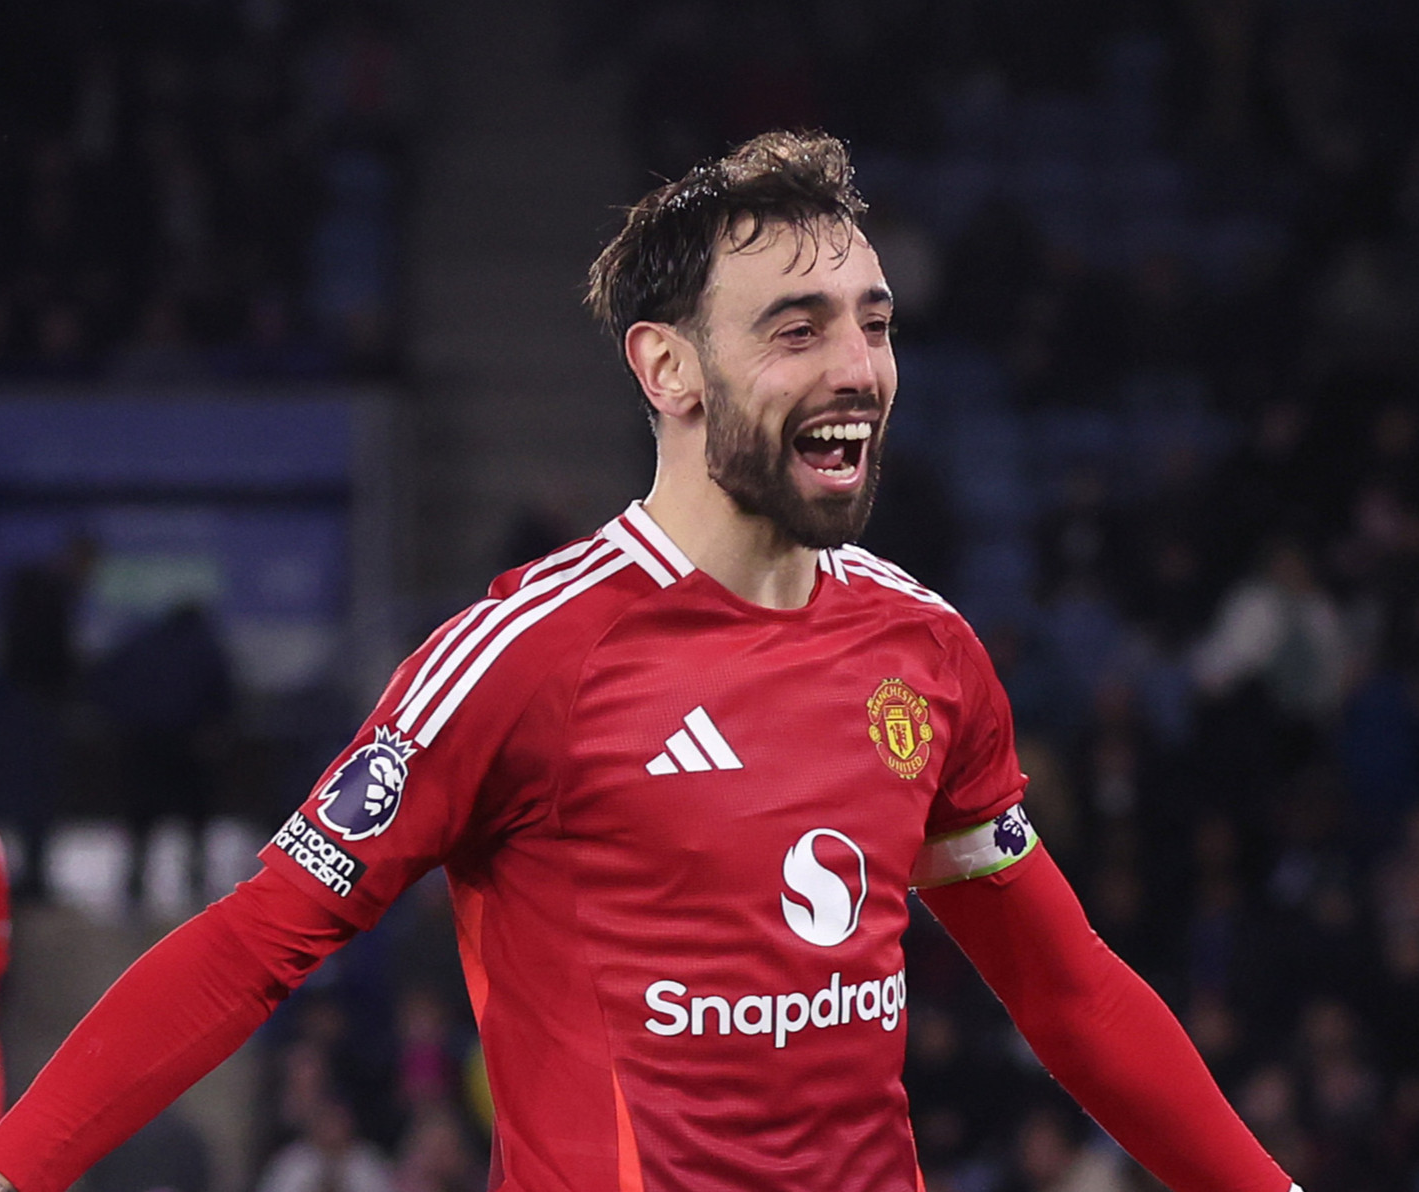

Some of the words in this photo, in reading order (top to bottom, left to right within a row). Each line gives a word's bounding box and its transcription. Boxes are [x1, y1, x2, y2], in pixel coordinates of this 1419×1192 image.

[872, 685, 923, 717] MANCHESTER
[888, 756, 922, 773] UNITED
[285, 811, 307, 836] No
[300, 828, 356, 877] room
[288, 841, 353, 898] racism
[644, 969, 907, 1048] Snapdrago
